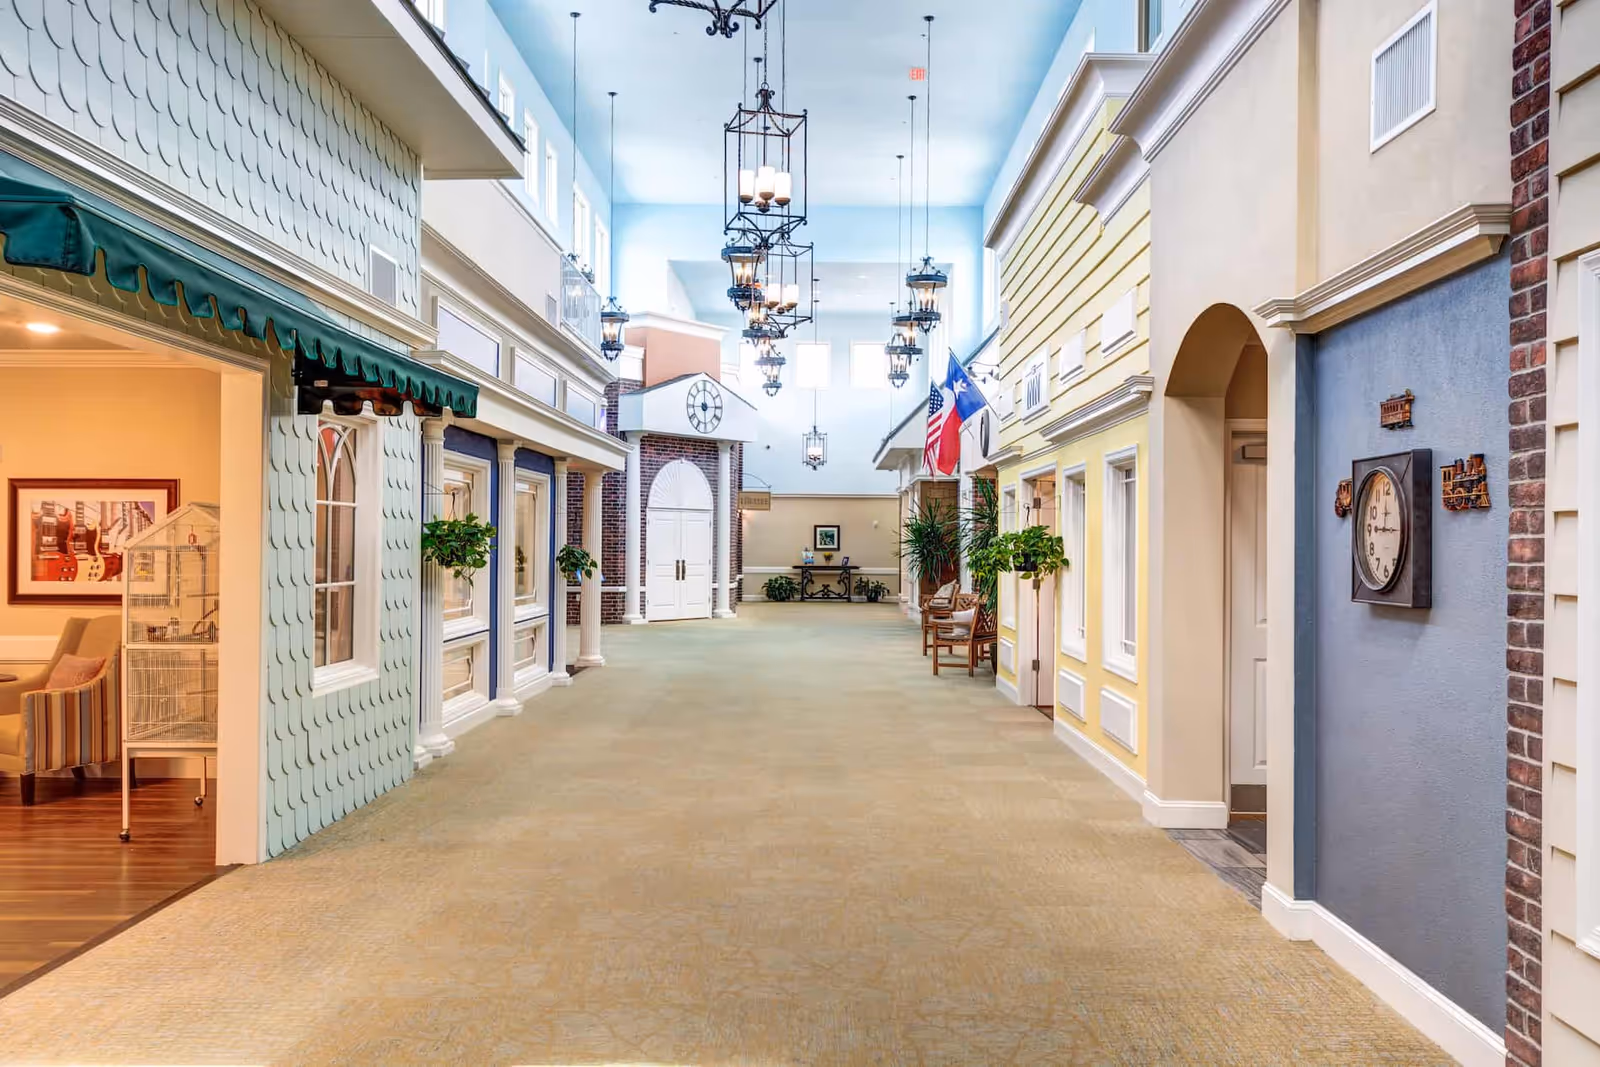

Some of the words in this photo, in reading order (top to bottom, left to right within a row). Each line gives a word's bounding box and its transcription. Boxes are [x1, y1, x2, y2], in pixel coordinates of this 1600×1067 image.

[1383, 481, 1391, 496] 12
[1369, 506, 1377, 520] 10
[1369, 542, 1374, 556] 8
[1375, 558, 1380, 571] 7
[1383, 565, 1389, 579] 6
